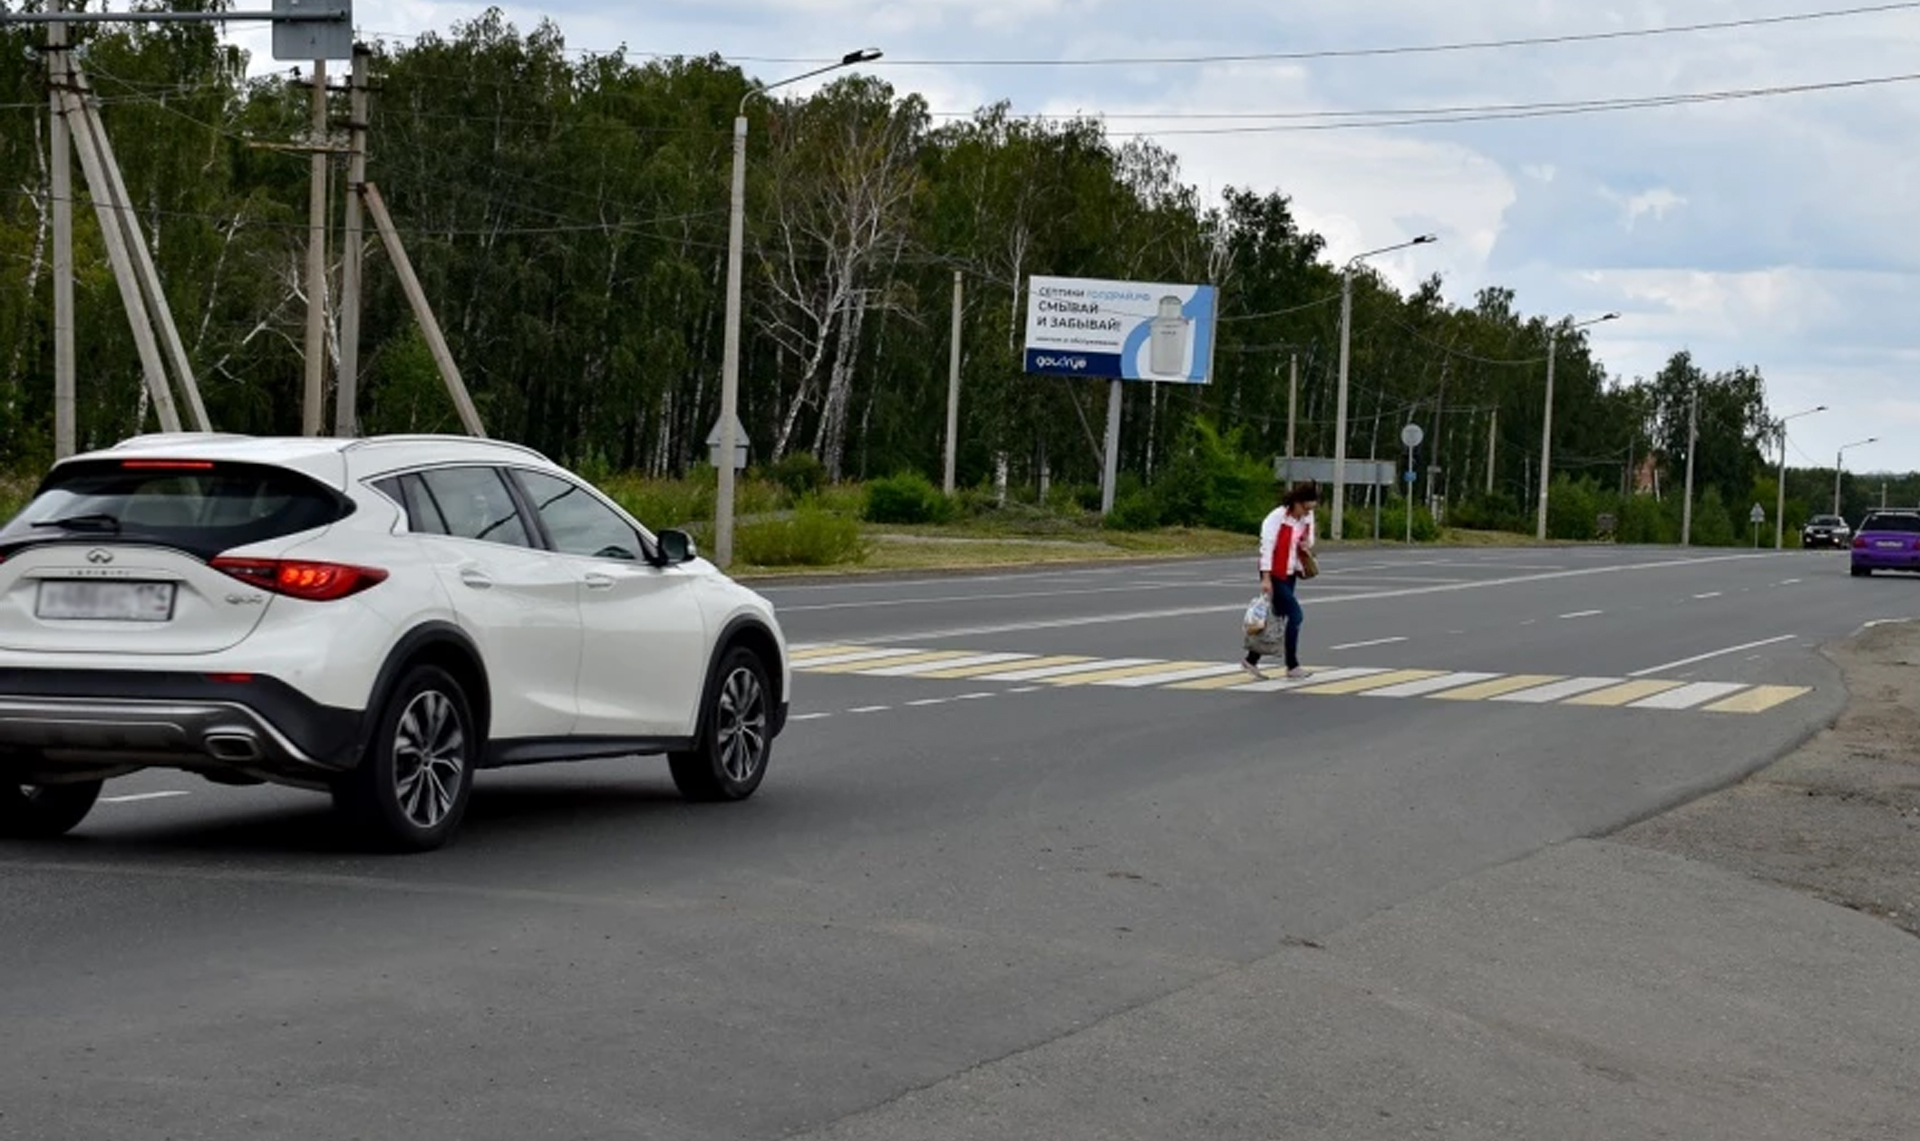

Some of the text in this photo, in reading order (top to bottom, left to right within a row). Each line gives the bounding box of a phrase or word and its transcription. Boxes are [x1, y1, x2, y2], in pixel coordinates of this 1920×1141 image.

[1038, 286, 1085, 297] СЕПТИКИ
[1038, 299, 1099, 314] СМЫВАЙ
[1036, 316, 1121, 331] И ЗАБЫВАЙ!
